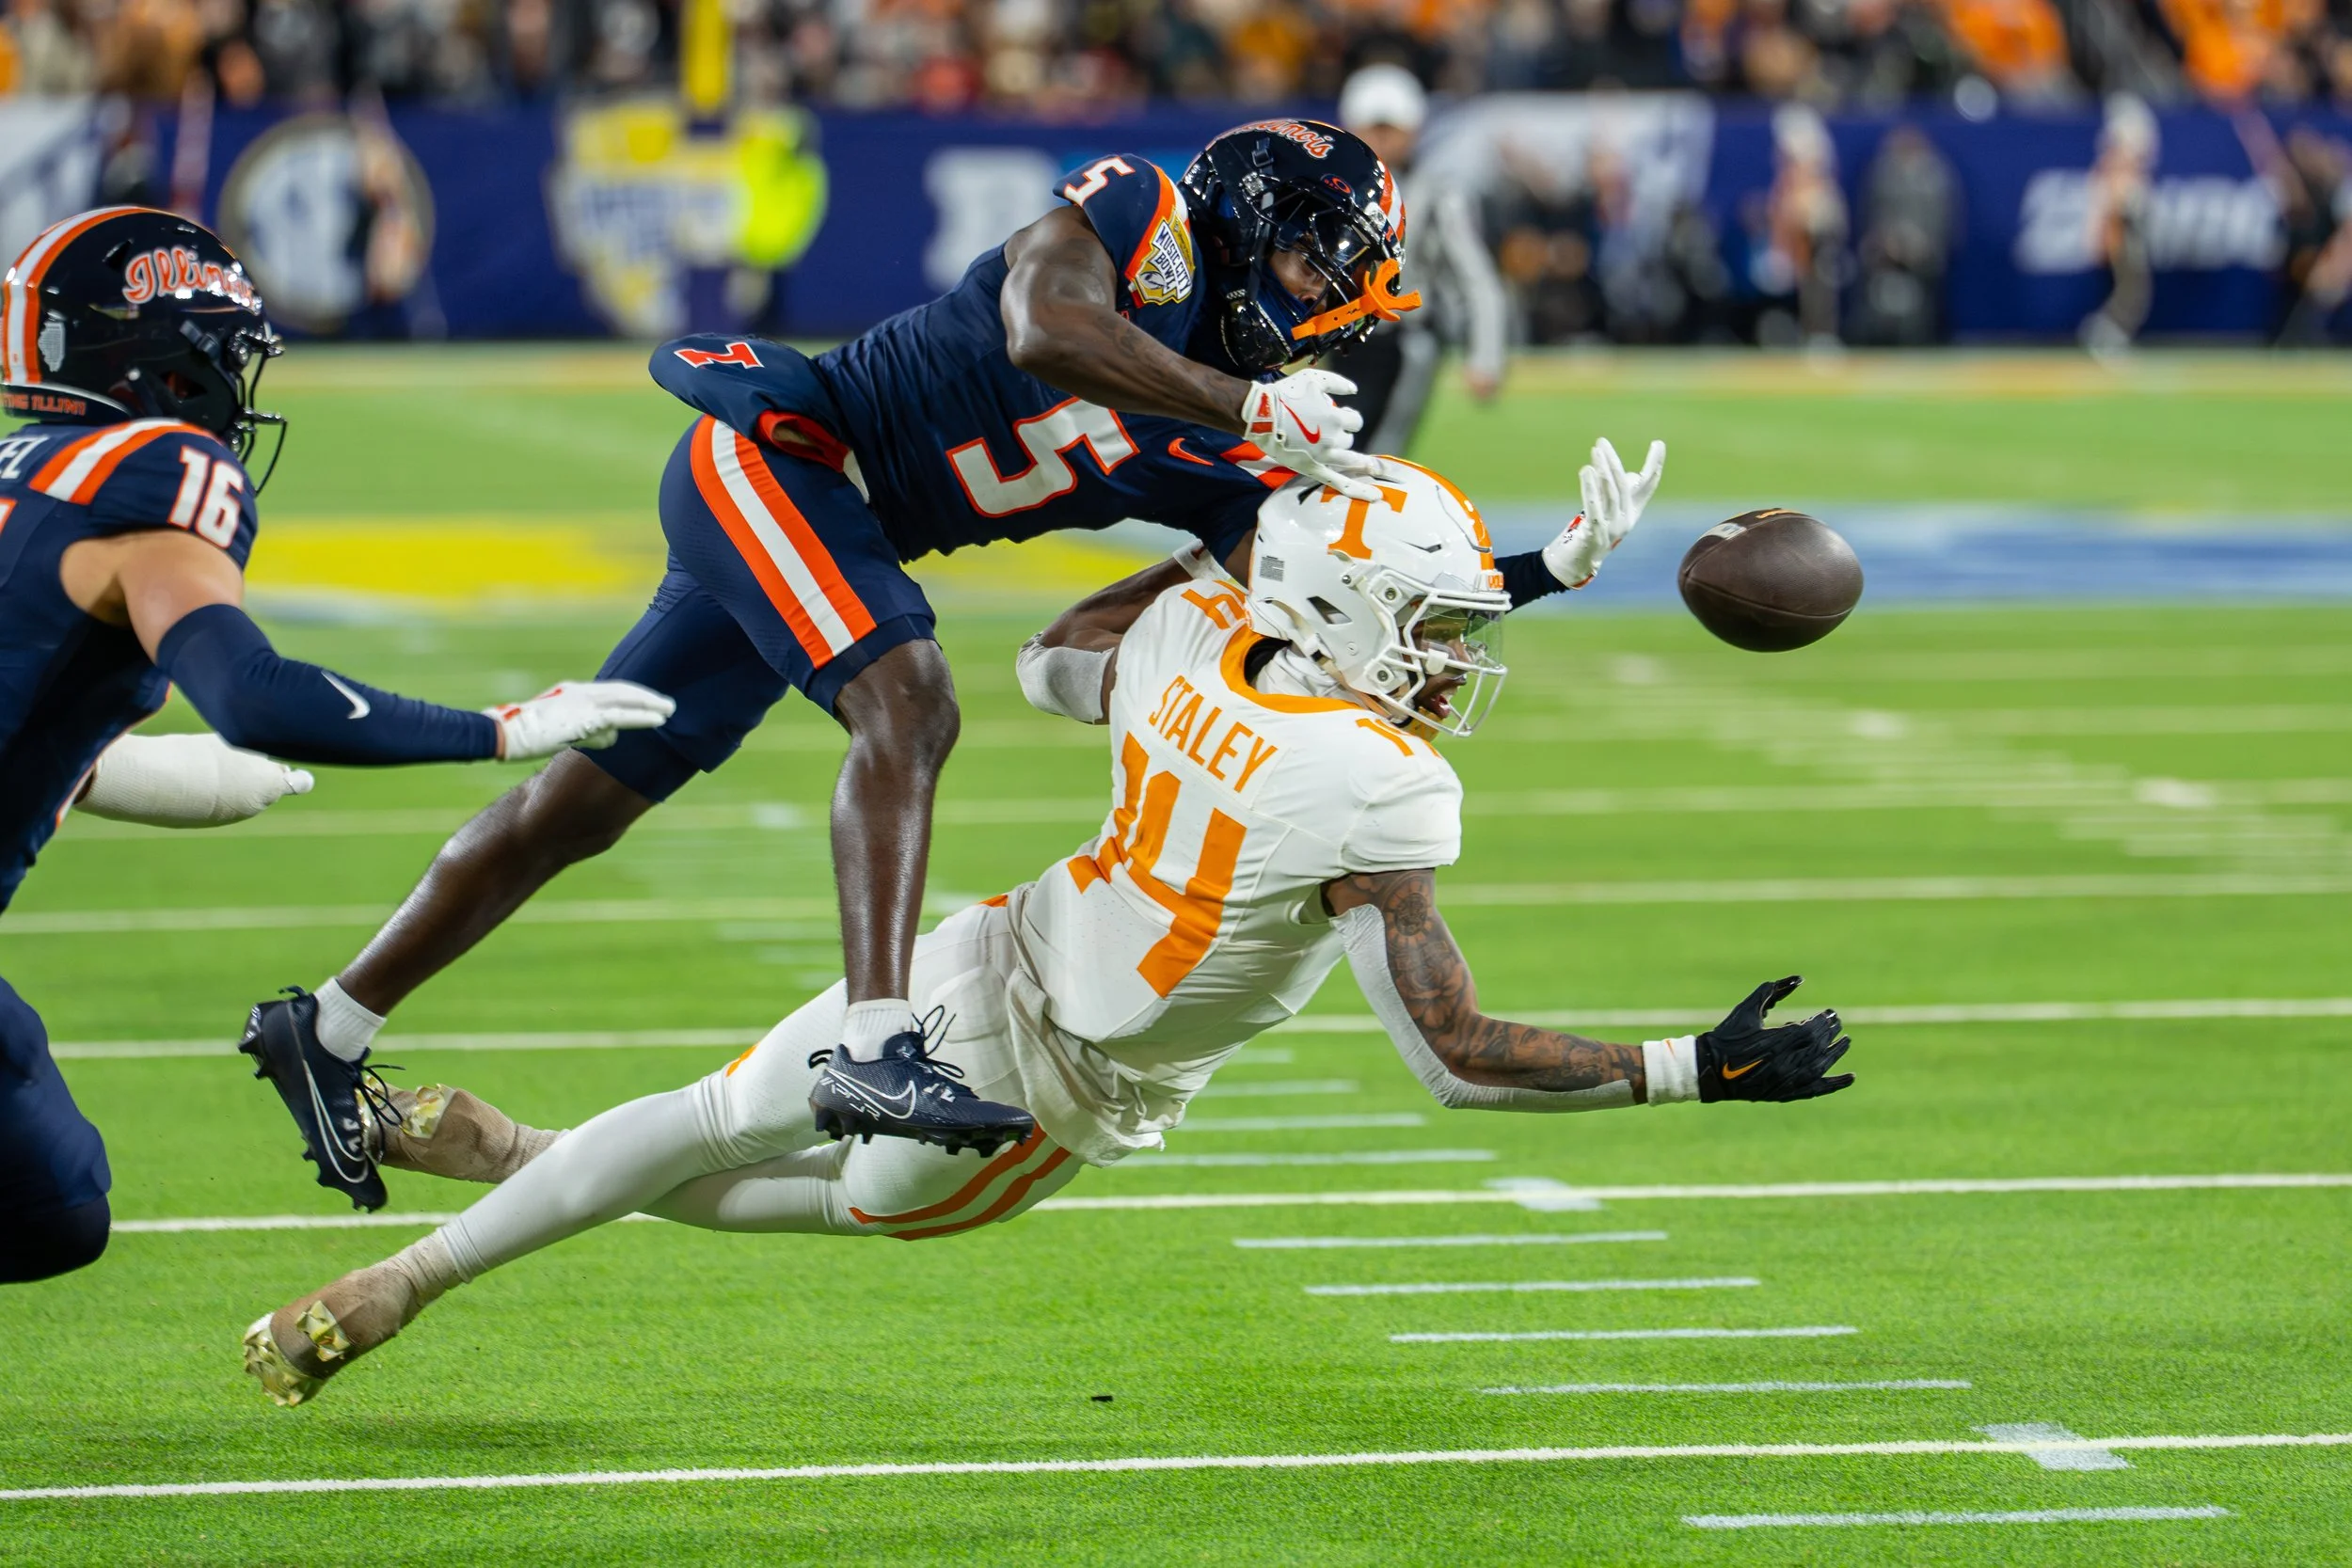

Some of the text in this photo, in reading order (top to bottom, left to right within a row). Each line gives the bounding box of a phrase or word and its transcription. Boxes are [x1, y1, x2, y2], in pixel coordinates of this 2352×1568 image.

[1063, 156, 1136, 210] 5
[1154, 252, 1177, 290] BOWL
[1156, 226, 1181, 265] MUSIC
[1175, 261, 1192, 293] CITY
[167, 446, 244, 549] 16
[946, 396, 1140, 518] 5
[1321, 484, 1408, 560] T
[1148, 674, 1278, 794] STALEY
[1067, 731, 1247, 999] 14
